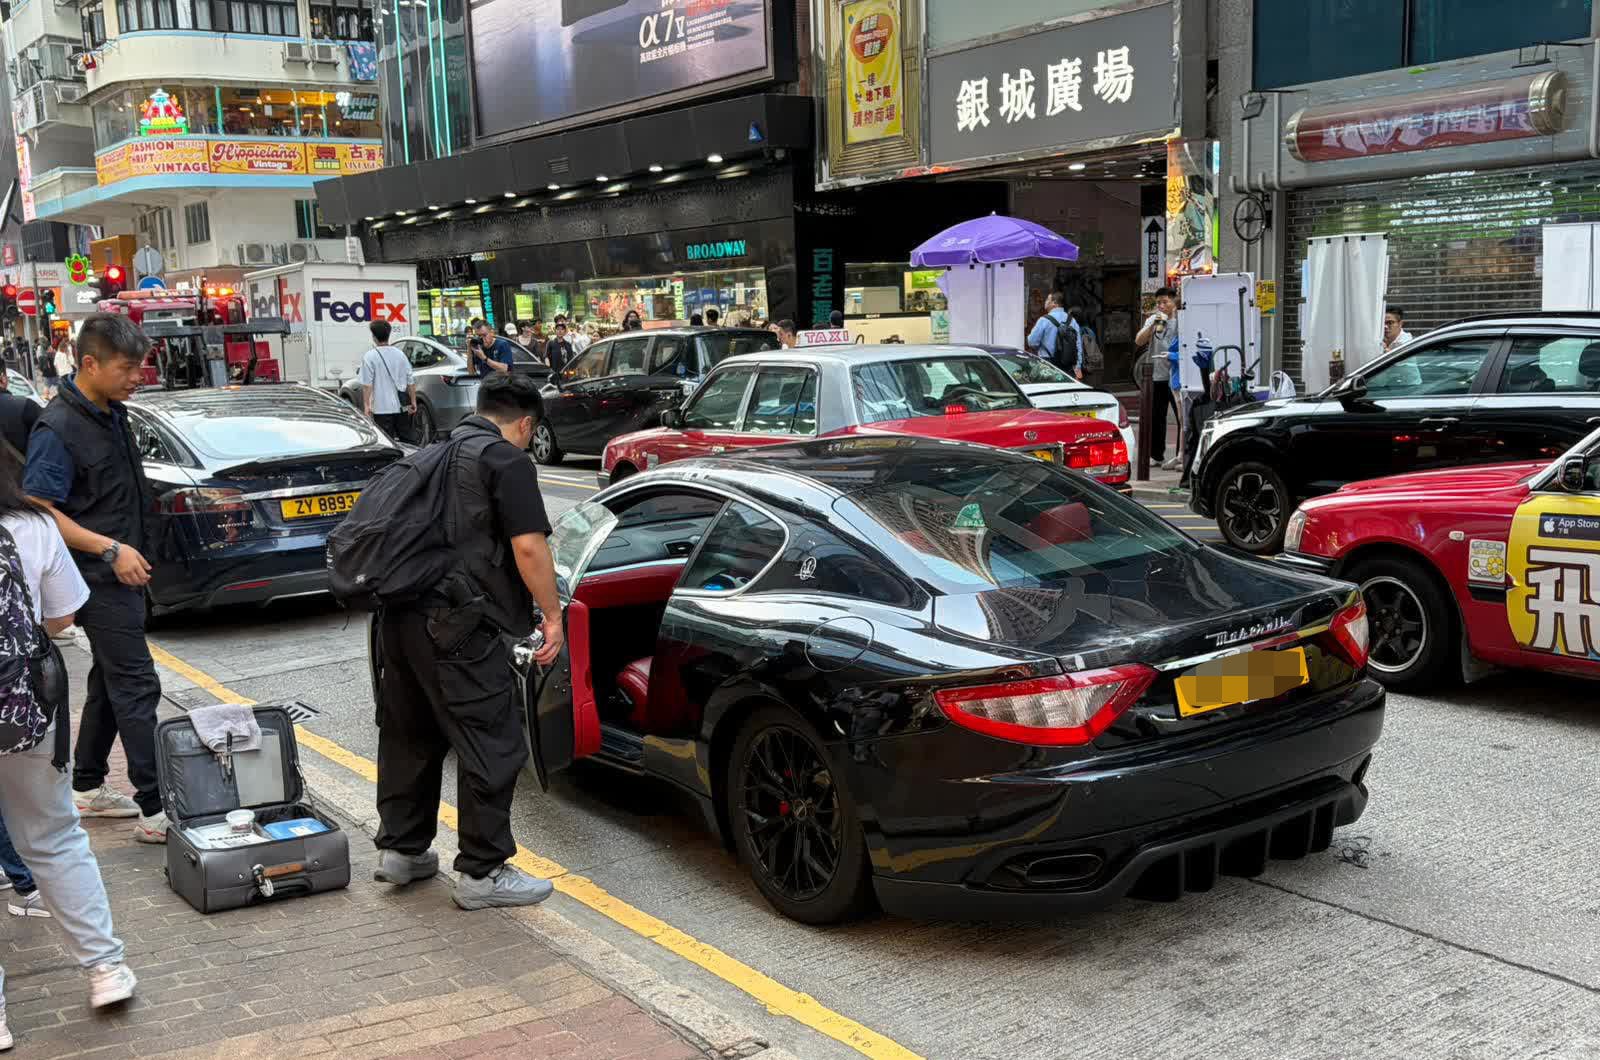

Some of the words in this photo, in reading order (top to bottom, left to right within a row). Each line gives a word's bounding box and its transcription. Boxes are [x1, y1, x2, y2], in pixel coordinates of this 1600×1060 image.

[956, 45, 1134, 132] 銀城廣場
[132, 141, 174, 152] FASHION
[212, 143, 298, 161] Hippieland
[153, 162, 208, 172] VINTAGE
[253, 160, 288, 170] Vintage
[687, 240, 746, 259] BROADWAY
[312, 290, 408, 323] FedEx
[805, 330, 849, 344] TAXI
[294, 498, 313, 514] ZY
[319, 494, 354, 511] 8893
[1558, 517, 1576, 529] App
[1577, 518, 1599, 529] Store
